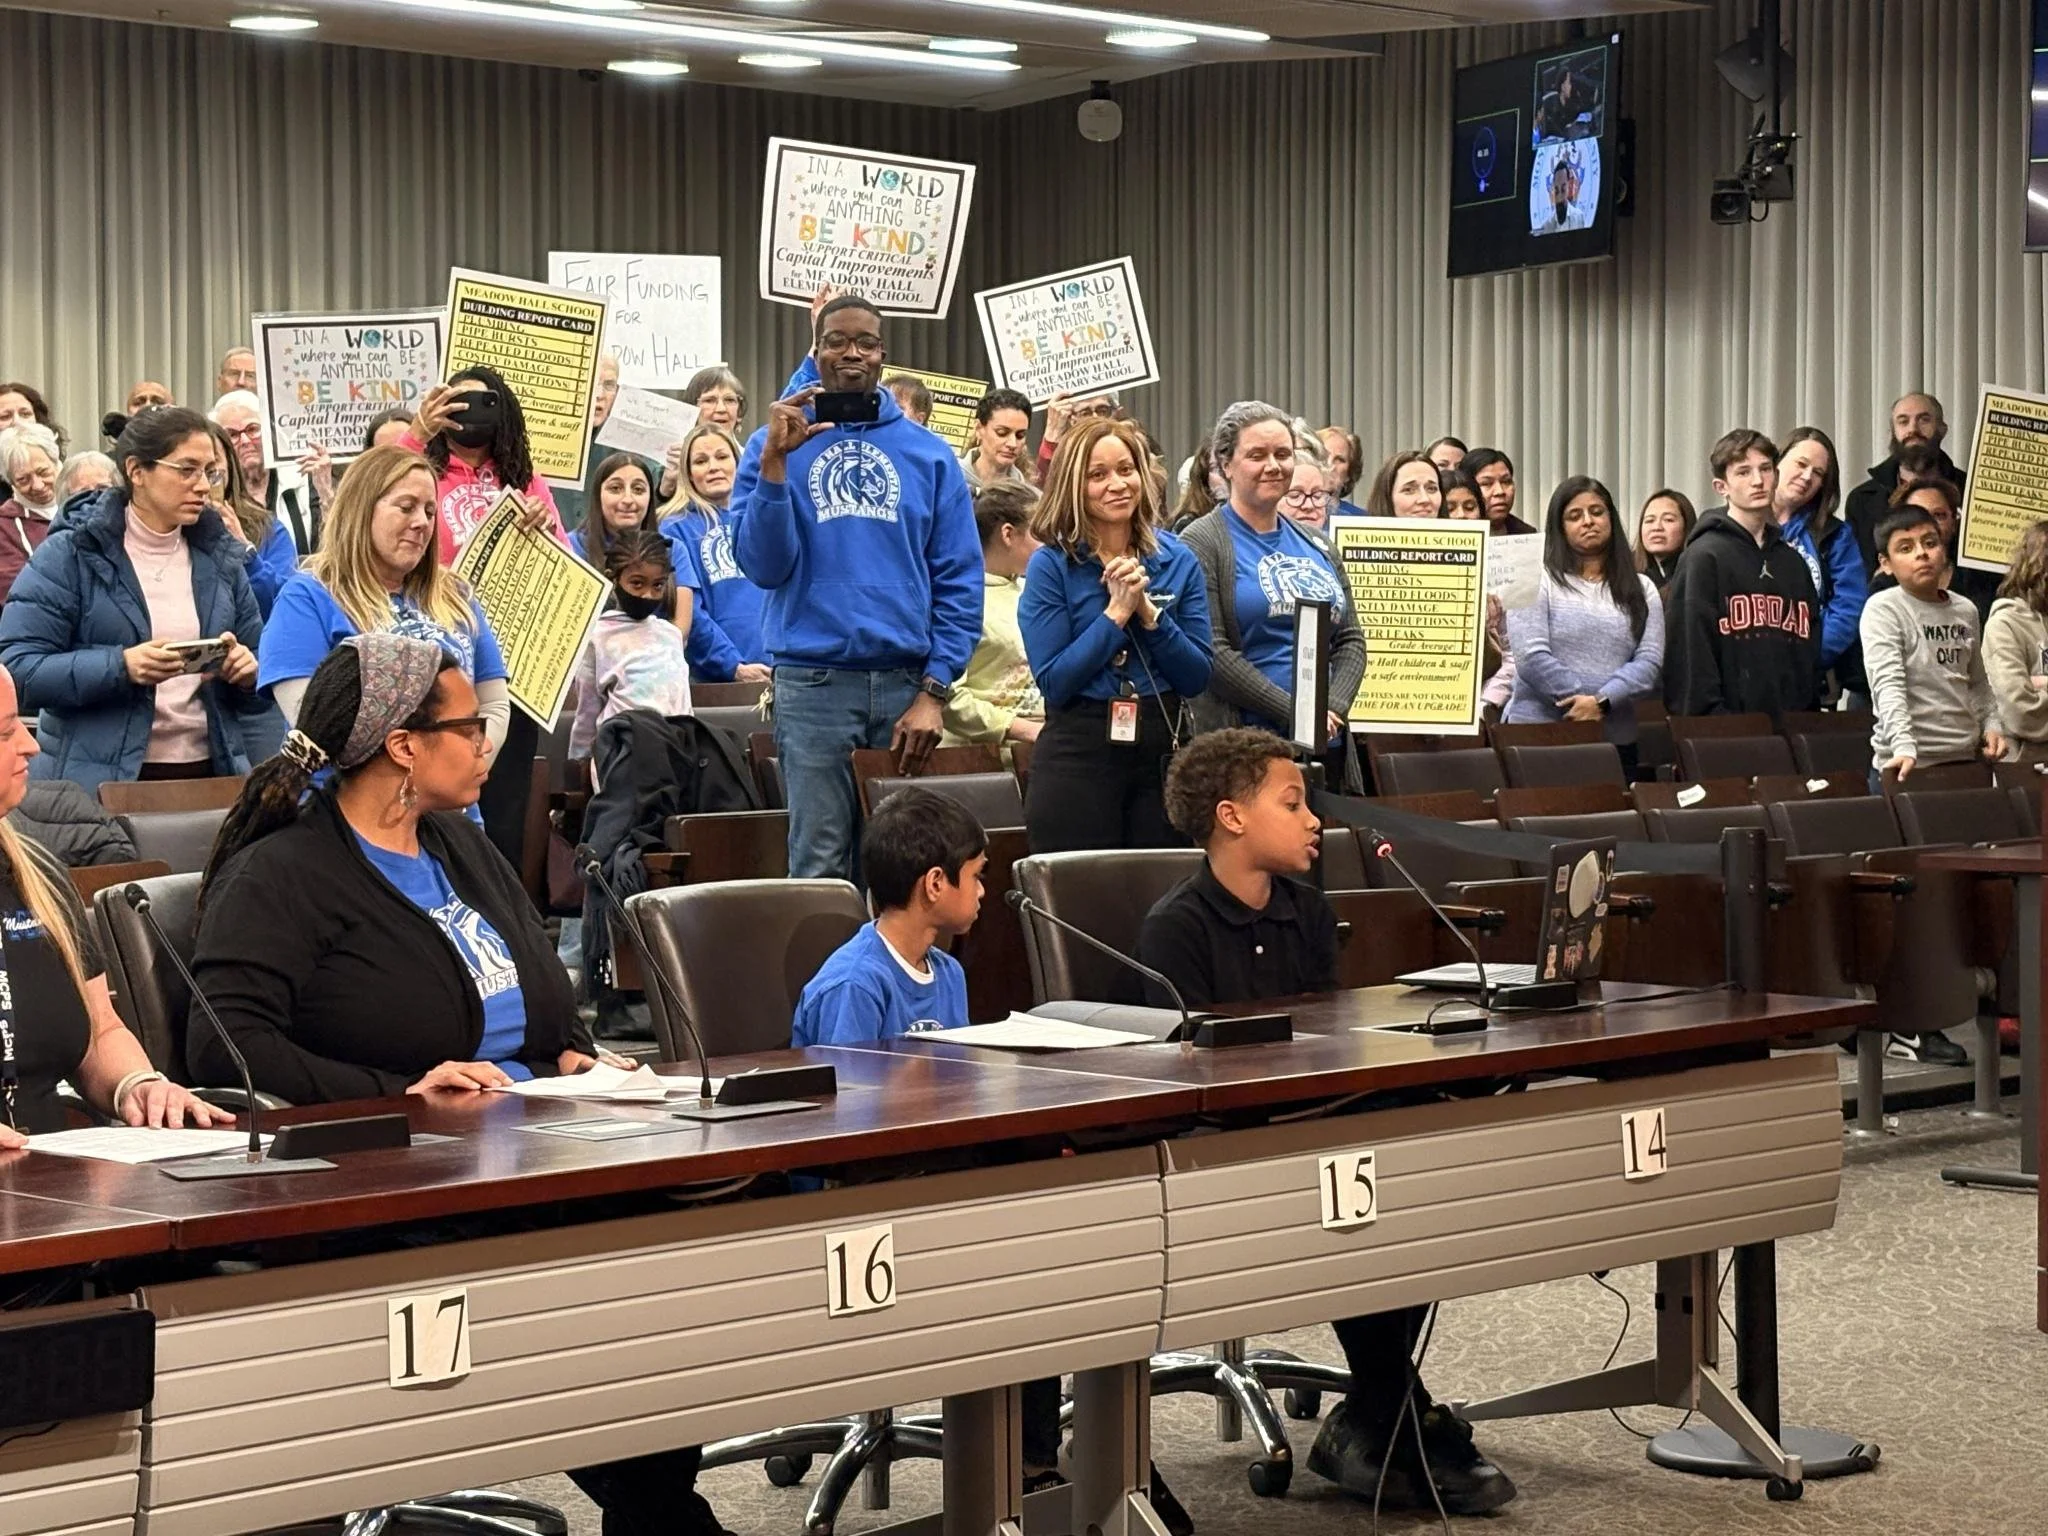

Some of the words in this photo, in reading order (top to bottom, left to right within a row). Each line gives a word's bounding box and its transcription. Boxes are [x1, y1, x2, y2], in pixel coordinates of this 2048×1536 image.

[807, 156, 829, 176] IN
[836, 161, 844, 177] A
[863, 164, 945, 198] WORLD
[810, 182, 848, 199] where
[853, 191, 873, 207] you
[880, 194, 902, 208] can
[914, 199, 932, 217] BE
[826, 199, 904, 227] ANYTHING
[799, 214, 836, 244] BE
[852, 223, 925, 255] KIND
[776, 247, 827, 268] Capital
[830, 255, 935, 280] Improvements
[801, 242, 855, 258] SUPPORT
[858, 250, 912, 265] CRITICAL
[626, 259, 709, 305] FUNDING
[805, 268, 873, 288] MEADOW
[876, 276, 914, 292] HALL
[464, 286, 517, 303] MEADOW
[518, 295, 550, 309] HALL
[551, 303, 598, 319] SCHOOL
[870, 290, 923, 303] SCHOOL
[1009, 294, 1027, 309] IN
[1032, 291, 1041, 303] A
[1050, 275, 1115, 303] WORLD
[463, 301, 516, 319] BUILDING
[517, 311, 560, 327] REPORT
[562, 320, 592, 332] CARD
[615, 310, 642, 324] FOR
[1019, 308, 1047, 323] where
[1051, 305, 1068, 315] you
[1072, 301, 1089, 311] can
[1099, 293, 1112, 309] BE
[464, 314, 525, 333] PLUMBING
[1037, 310, 1095, 334] ANYTHING
[293, 329, 314, 345] IN
[321, 329, 330, 344] A
[345, 329, 424, 349] WORLD
[462, 325, 489, 339] PIPE
[492, 331, 538, 347] BURSTS
[1021, 335, 1052, 360] BE
[1061, 320, 1118, 350] KIND
[300, 350, 336, 362] where
[342, 352, 361, 365] you
[368, 351, 388, 362] can
[400, 350, 416, 365] BE
[458, 349, 501, 365] COSTLY
[504, 357, 552, 373] DAMAGE
[460, 338, 521, 357] REPEATED
[524, 349, 571, 365] FLOODS
[652, 332, 704, 376] HALL
[1029, 350, 1069, 368] SUPPORT
[1071, 341, 1113, 357] CRITICAL
[320, 363, 392, 379] ANYTHING
[1010, 363, 1051, 383] Capital
[1054, 345, 1135, 372] Improvements
[1038, 367, 1090, 386] MEADOW
[1093, 359, 1125, 374] HALL
[1092, 366, 1135, 382] SCHOOL
[297, 380, 333, 405] BE
[347, 380, 418, 401] KIND
[934, 393, 955, 403] PORT
[956, 396, 978, 406] CARD
[303, 403, 356, 414] SUPPORT
[1992, 400, 2032, 414] MEADOW
[278, 411, 328, 429] Capital
[1991, 413, 2032, 428] BUILDING
[810, 458, 828, 508] MEADOW
[817, 505, 898, 523] MUSTANGS
[471, 542, 494, 583] REPORT
[492, 512, 514, 541] CARD
[1344, 534, 1398, 544] MEADOW
[1401, 535, 1431, 545] HALL
[1433, 536, 1478, 547] SCHOOL
[1345, 549, 1398, 561] BUILDING
[1400, 552, 1443, 561] REPORT
[1445, 553, 1475, 562] CARD
[1346, 563, 1410, 574] PLUMBING
[1377, 576, 1423, 586] BURSTS
[1354, 589, 1407, 600] EPEATED
[1410, 590, 1457, 600] FLOODS
[1390, 603, 1440, 613] DAMAGE
[1381, 615, 1457, 625] DISRUPTIONS
[1387, 629, 1425, 639] LEAKS
[1389, 641, 1416, 650] Grade
[1377, 658, 1398, 666] Hall
[1399, 659, 1437, 668] children
[1450, 660, 1472, 671] staff
[1936, 648, 1962, 664] OUT
[1378, 672, 1398, 681] safe
[1400, 673, 1460, 682] environment!
[1380, 701, 1400, 709] FOR
[1417, 702, 1467, 711] UPGRADE!
[0, 970, 13, 1011] MCPS
[1623, 1111, 1667, 1174] 14
[1323, 1155, 1374, 1222] 15
[831, 1232, 893, 1312] 16
[394, 1294, 466, 1380] 17
